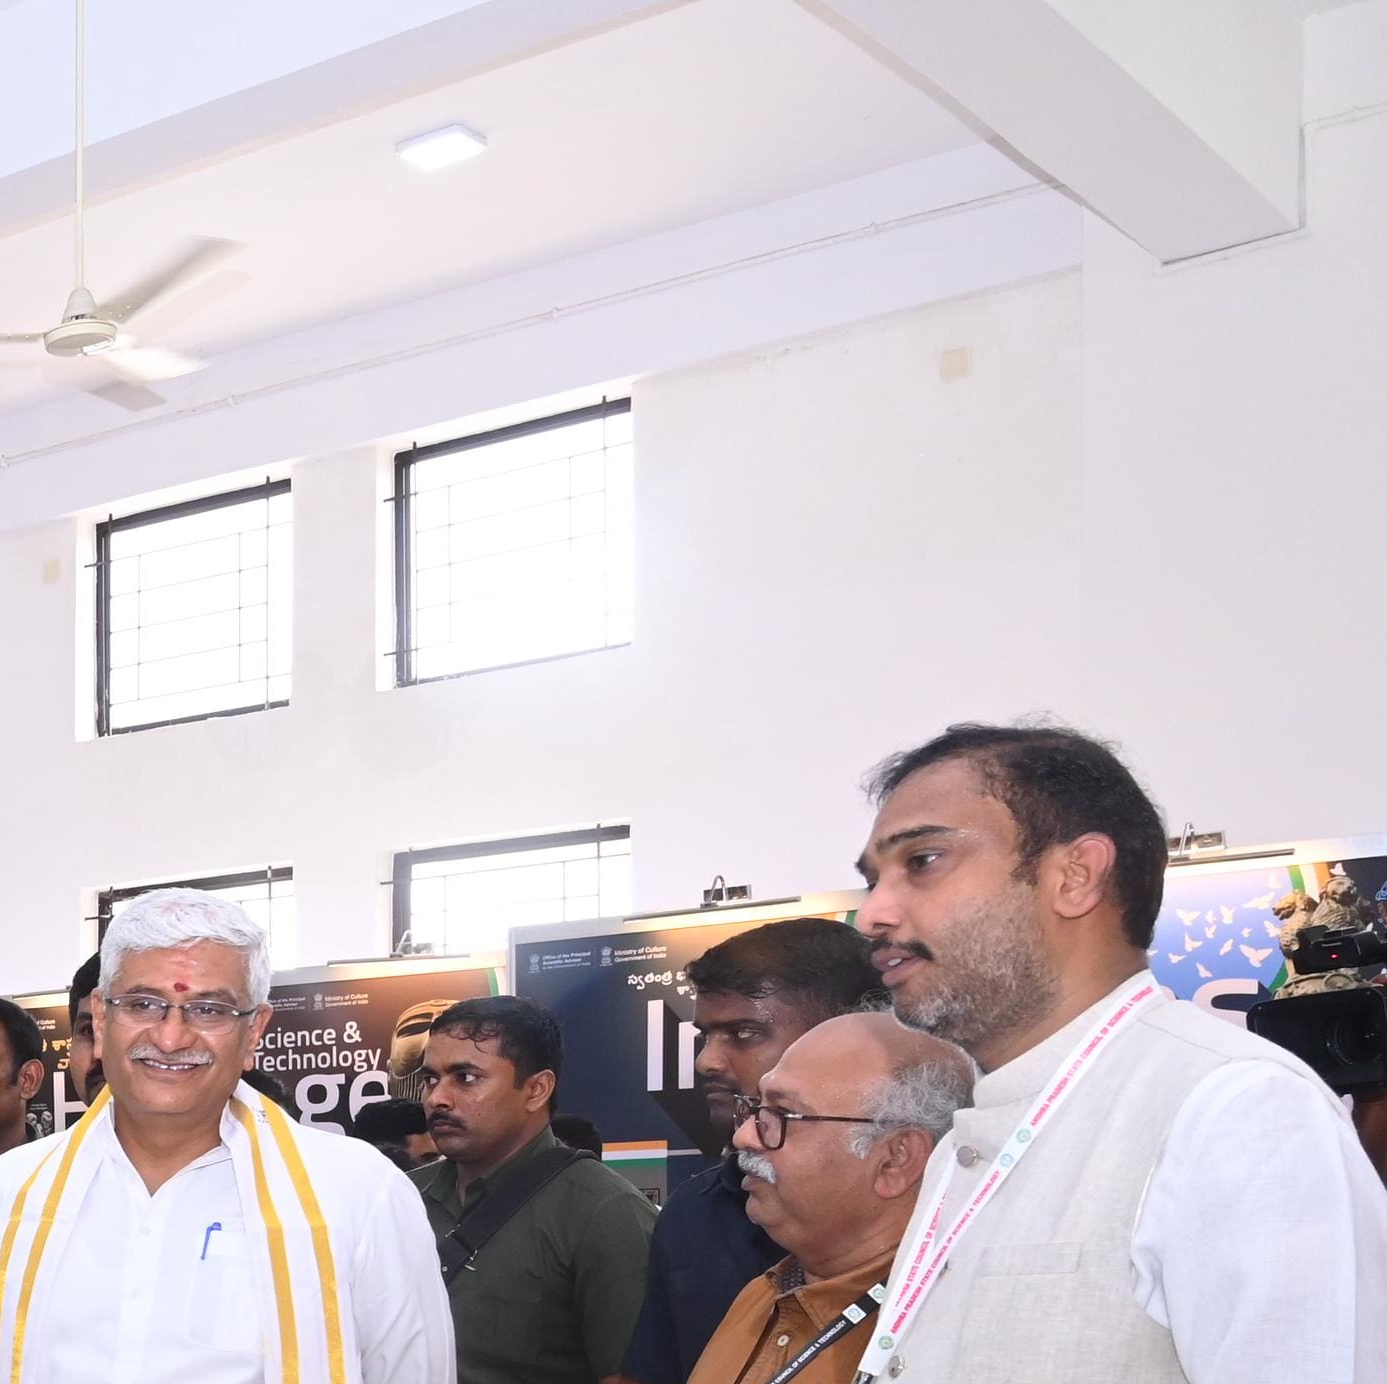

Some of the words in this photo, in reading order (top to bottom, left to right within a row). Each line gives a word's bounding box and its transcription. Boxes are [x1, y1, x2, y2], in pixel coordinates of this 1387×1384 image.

[342, 1020, 363, 1044] &
[1080, 1035, 1104, 1059] COUNCIL
[1099, 1026, 1110, 1036] OF
[1106, 1005, 1131, 1028] SCIENCE
[254, 1045, 382, 1072] Technology
[930, 1245, 949, 1270] COUNCIL
[946, 1235, 954, 1246] OF
[951, 1211, 972, 1238] SCIENCE
[972, 1170, 1001, 1208] TECHNOLOGY
[914, 1241, 931, 1267] COUNCIL
[774, 1366, 794, 1384] COUNCIL
[790, 1360, 800, 1371] OF
[796, 1345, 817, 1362] SCIENCE
[817, 1320, 848, 1346] TECHNOLOGY
